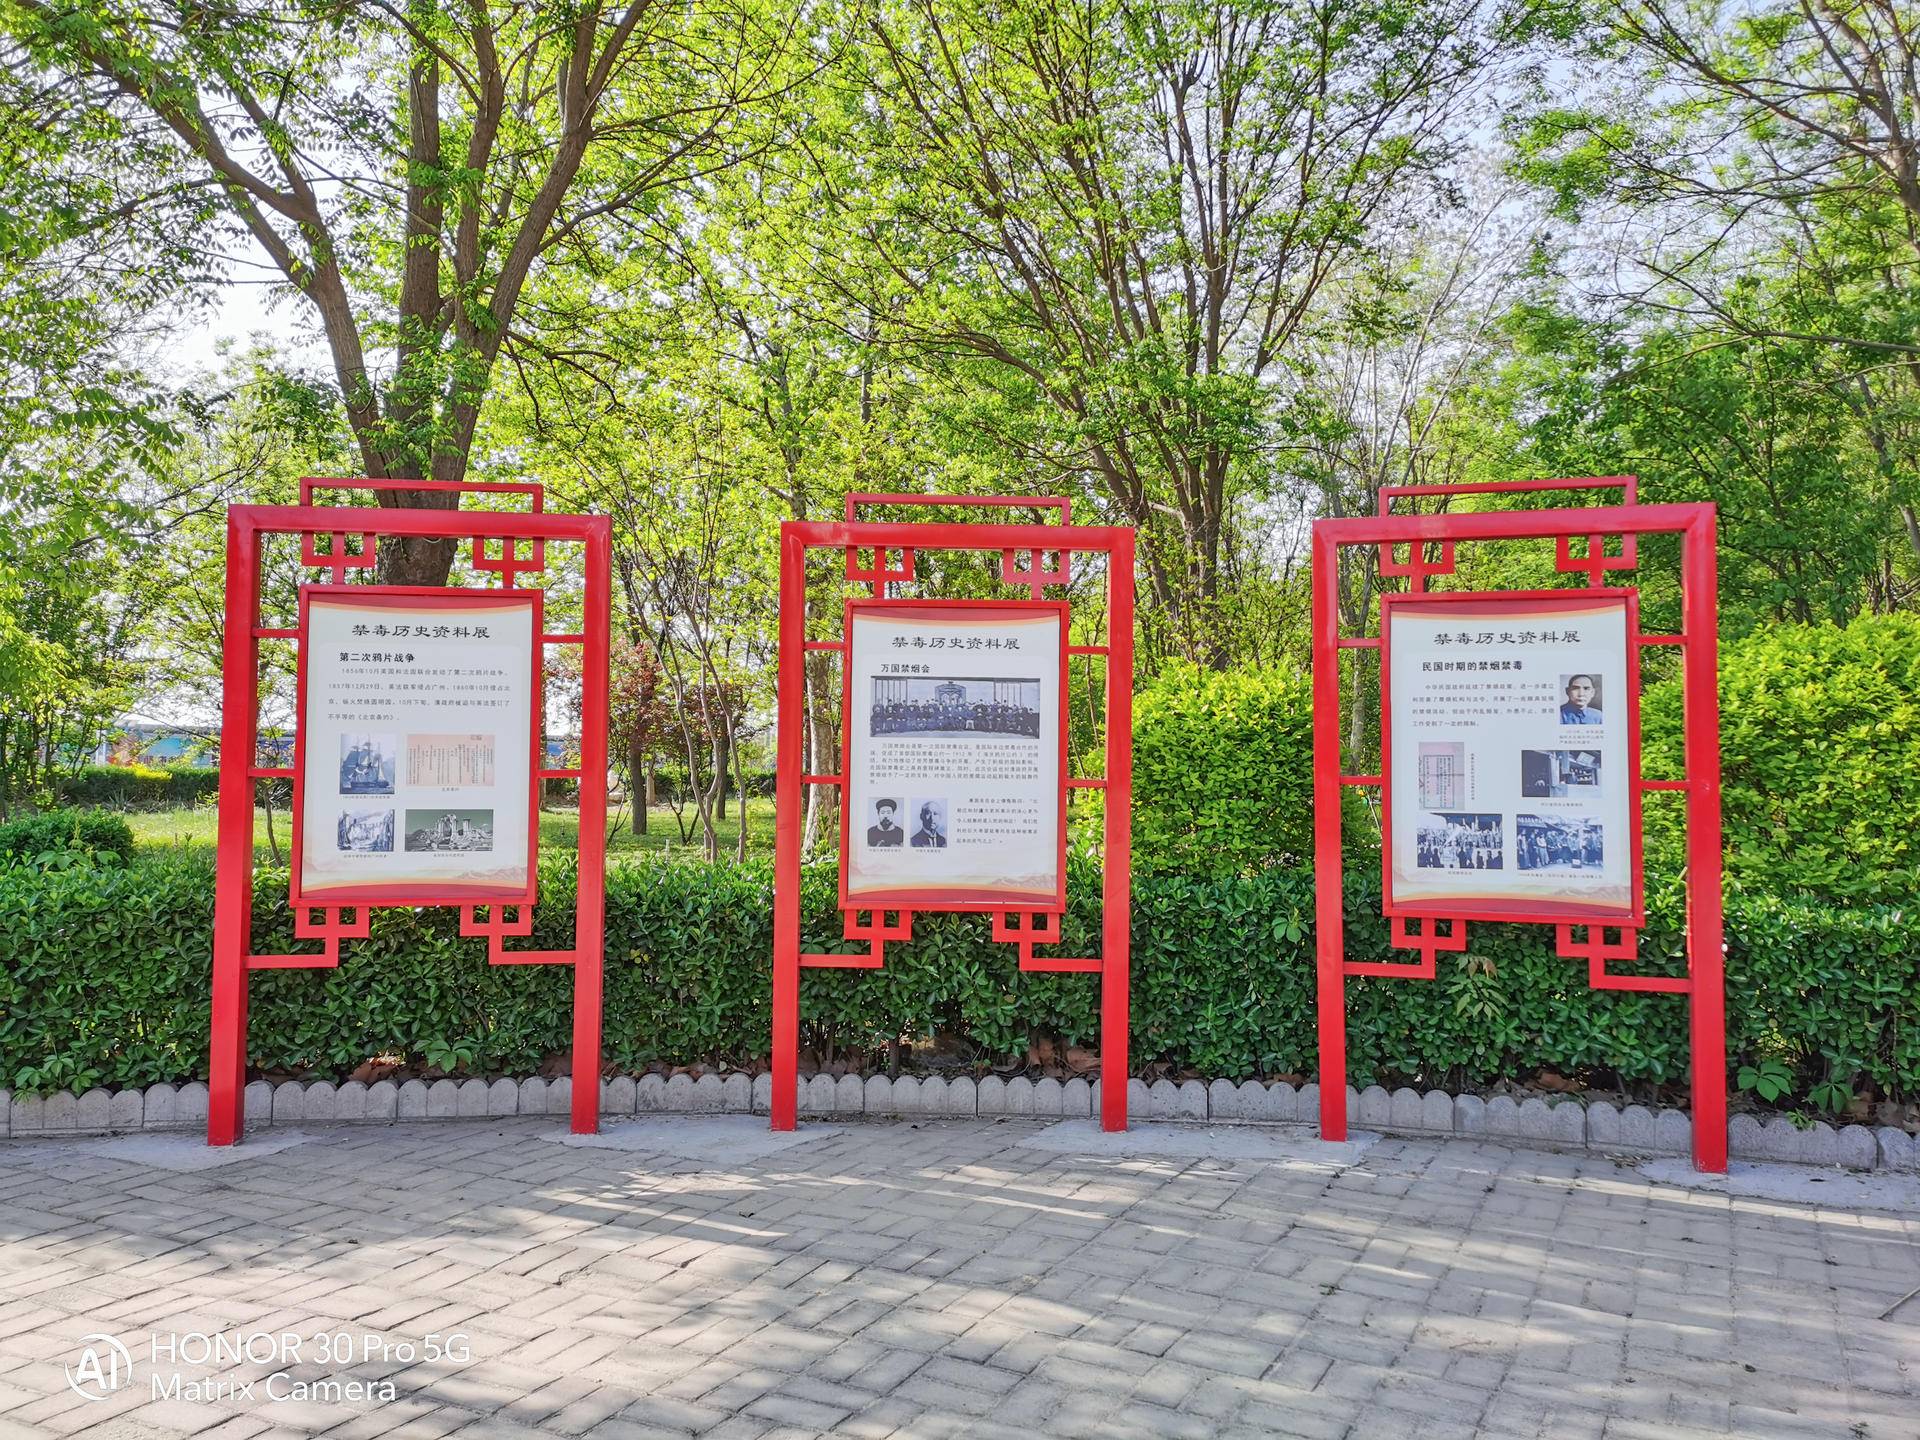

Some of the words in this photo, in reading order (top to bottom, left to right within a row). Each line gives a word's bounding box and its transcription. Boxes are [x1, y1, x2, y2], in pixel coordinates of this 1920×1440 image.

[351, 623, 491, 639] 禁毒历史资料展
[891, 635, 1021, 650] 禁毒历史资料展
[1433, 630, 1582, 646] 禁毒历史资料展
[339, 652, 416, 663] 第二次鸦片战争
[880, 663, 931, 674] 万国禁烟会
[1422, 660, 1524, 672] 民国时期的禁烟禁毒
